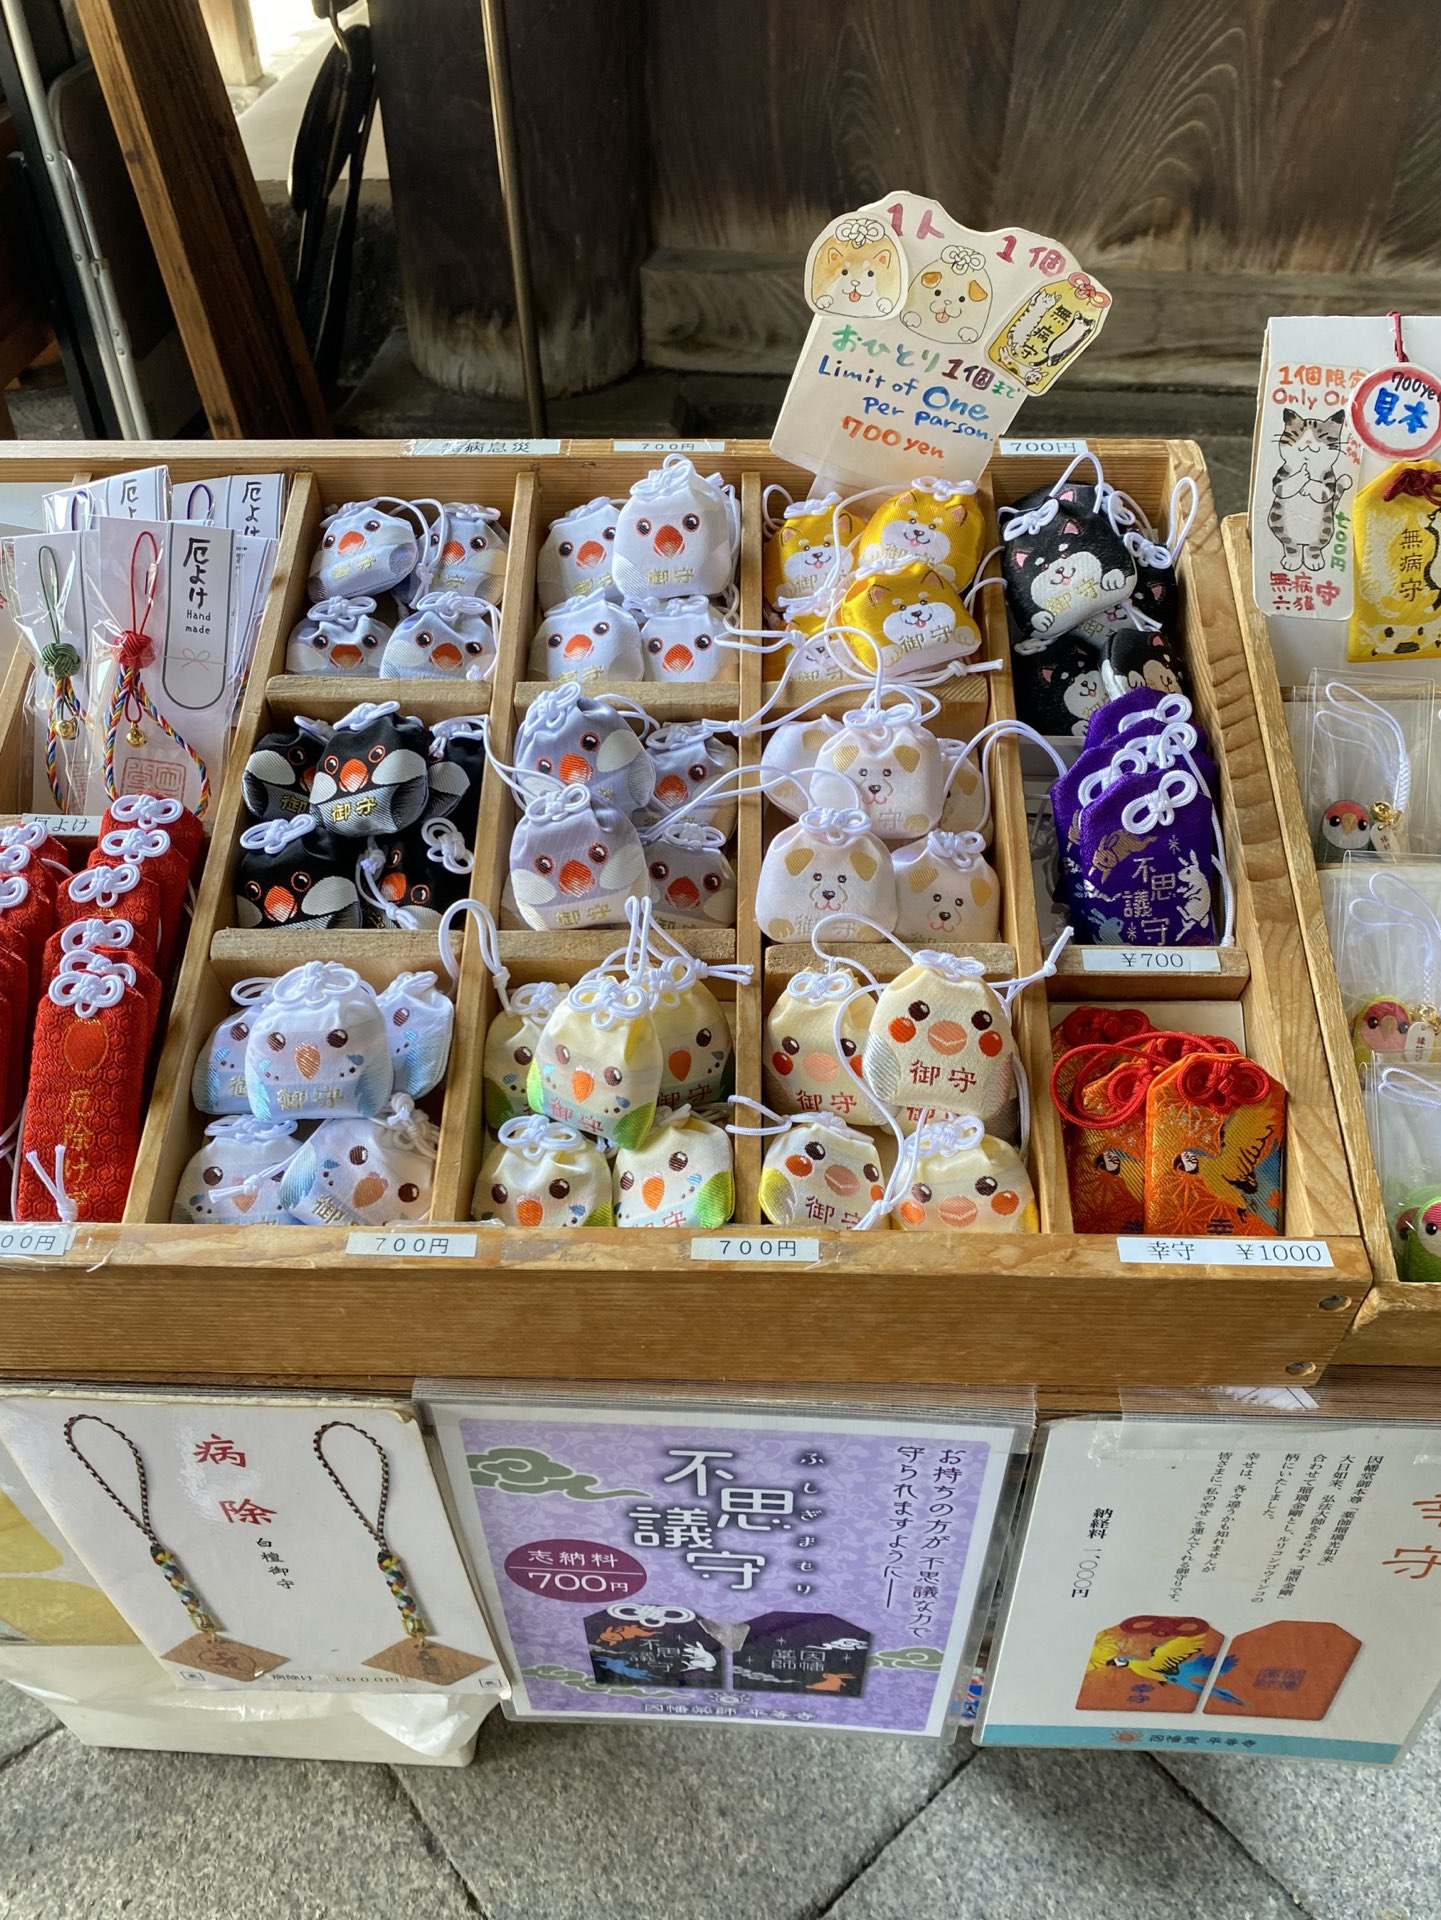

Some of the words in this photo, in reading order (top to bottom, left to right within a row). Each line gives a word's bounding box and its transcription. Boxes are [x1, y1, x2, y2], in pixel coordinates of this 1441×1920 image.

[887, 202, 945, 240] 1人
[996, 234, 1066, 276] 1個
[1019, 303, 1073, 360] 無病守
[817, 355, 886, 388] Limit
[891, 379, 918, 396] of
[922, 385, 989, 422] One
[1271, 388, 1318, 412] Only
[1391, 371, 1441, 403] 700ye
[1374, 386, 1428, 434] 見本
[640, 442, 696, 452] 700円
[843, 416, 901, 447] 700
[903, 436, 944, 459] yen
[1010, 441, 1077, 454] 700円
[183, 537, 210, 610] 厄よけ
[648, 567, 695, 585] 御守
[1400, 528, 1423, 602] 無病守
[1045, 577, 1101, 616] 御守
[186, 609, 212, 622] Hand
[185, 625, 211, 635] made
[901, 624, 954, 651] 御守
[331, 796, 377, 823] 御守
[1122, 856, 1177, 946] 不思議守
[555, 903, 613, 927] 御守
[1121, 952, 1184, 969] ¥700
[910, 1058, 977, 1094] 御守
[276, 1085, 344, 1112] 御守
[796, 1090, 858, 1114] 御守
[550, 1096, 604, 1134] 御守
[376, 1237, 449, 1254] 700円
[719, 1239, 797, 1257] 700円
[1147, 1240, 1195, 1261] 幸守
[1235, 1243, 1323, 1263] ¥1000
[629, 1448, 795, 1590] 不思議守
[528, 1549, 618, 1569] 志納料
[527, 1571, 629, 1593] 700円
